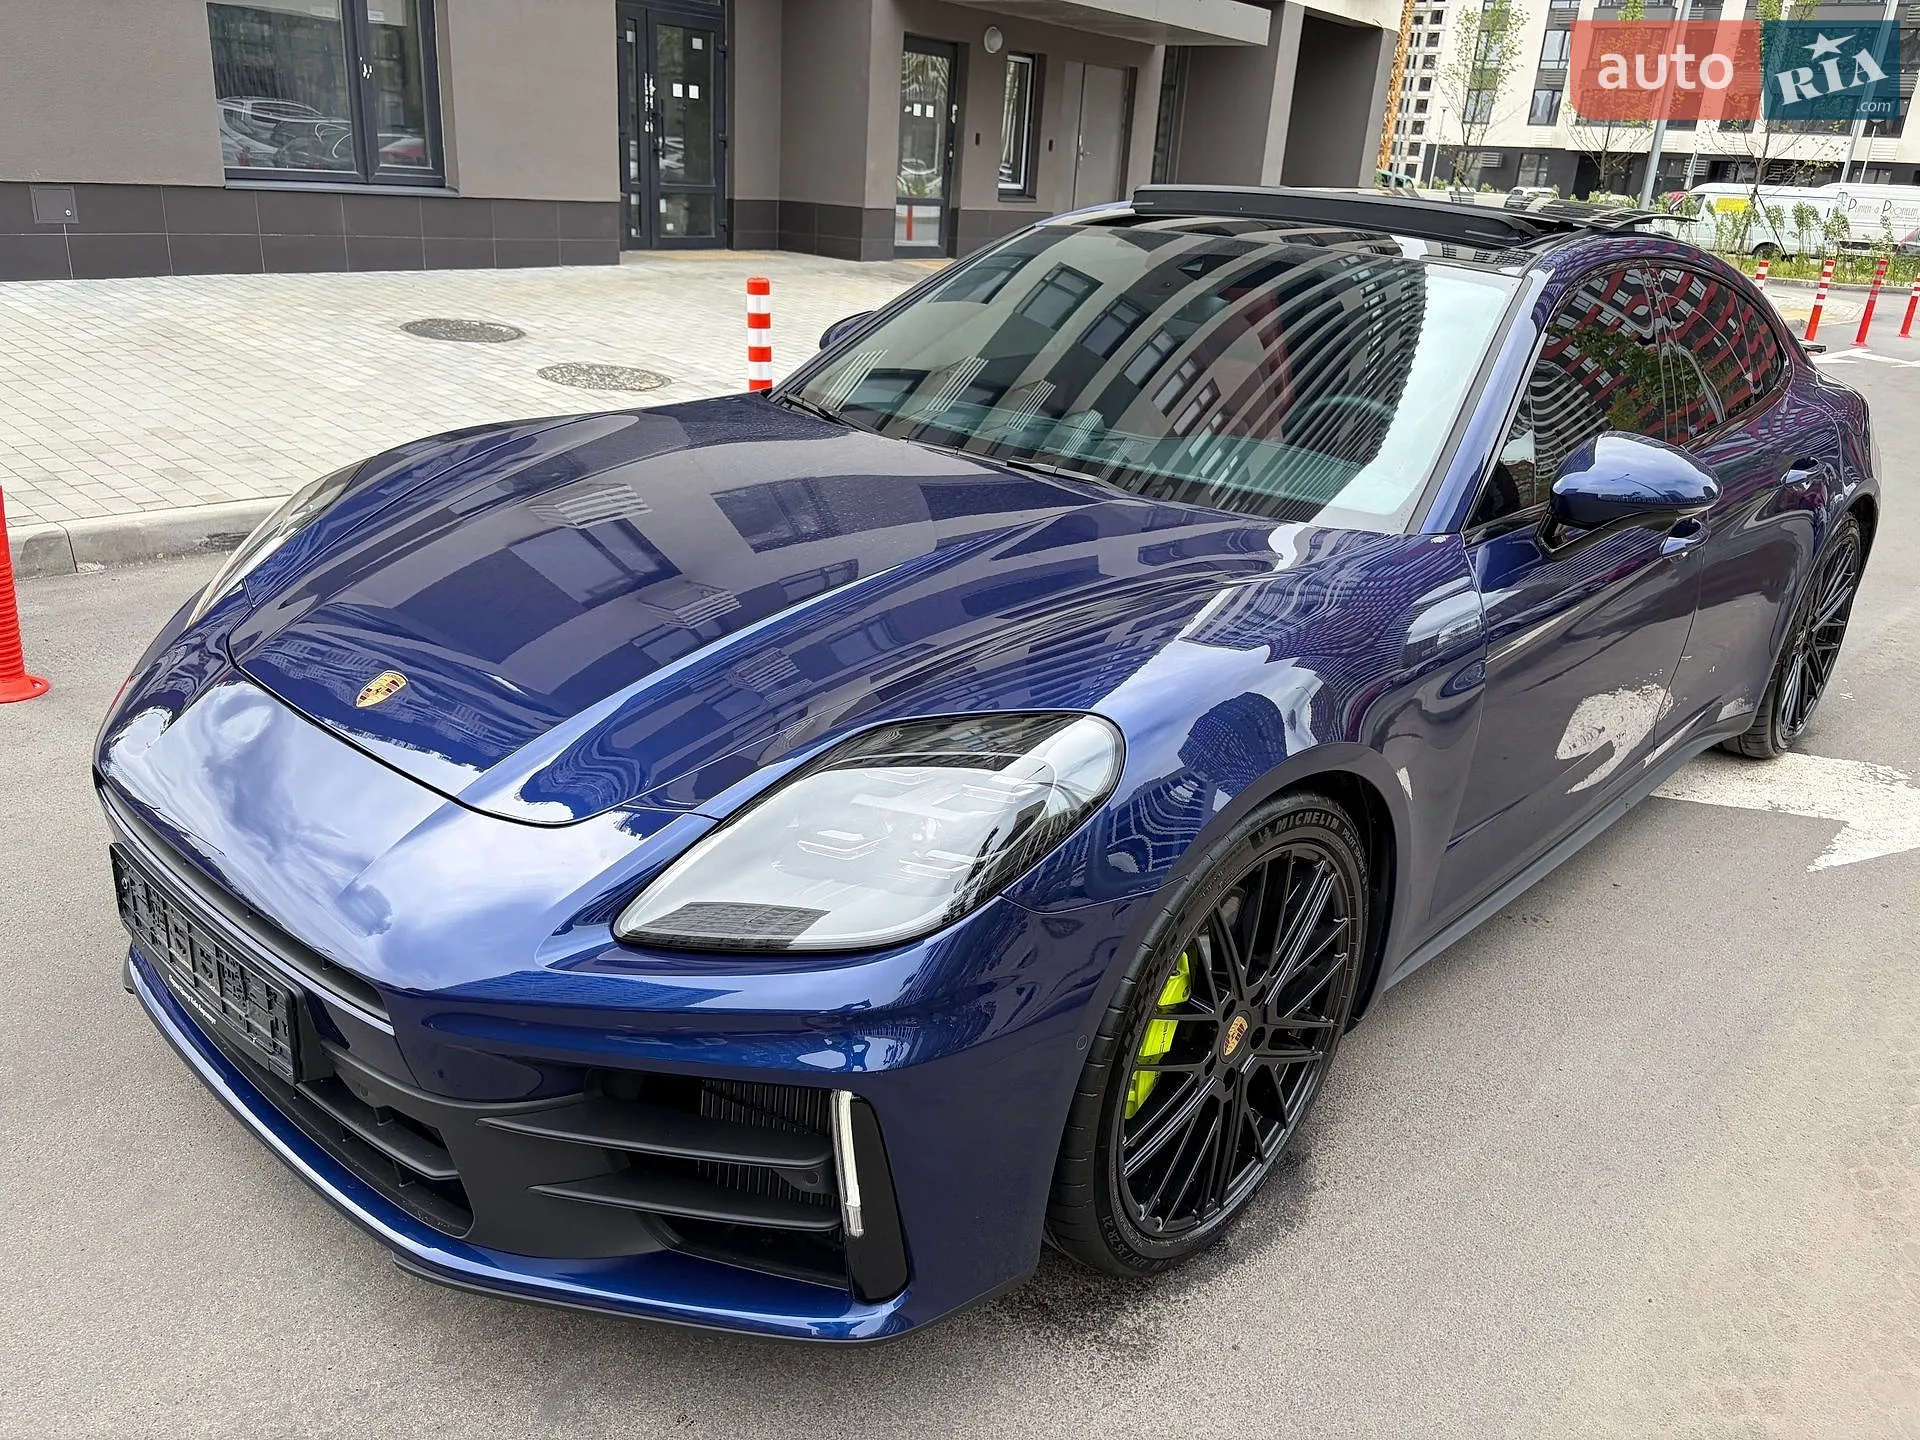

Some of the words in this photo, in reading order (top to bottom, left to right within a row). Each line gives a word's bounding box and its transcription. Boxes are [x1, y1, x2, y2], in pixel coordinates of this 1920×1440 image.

[1275, 812, 1340, 834] MICHELIN
[1342, 827, 1357, 849] PILOT
[1353, 848, 1366, 875] SPORT
